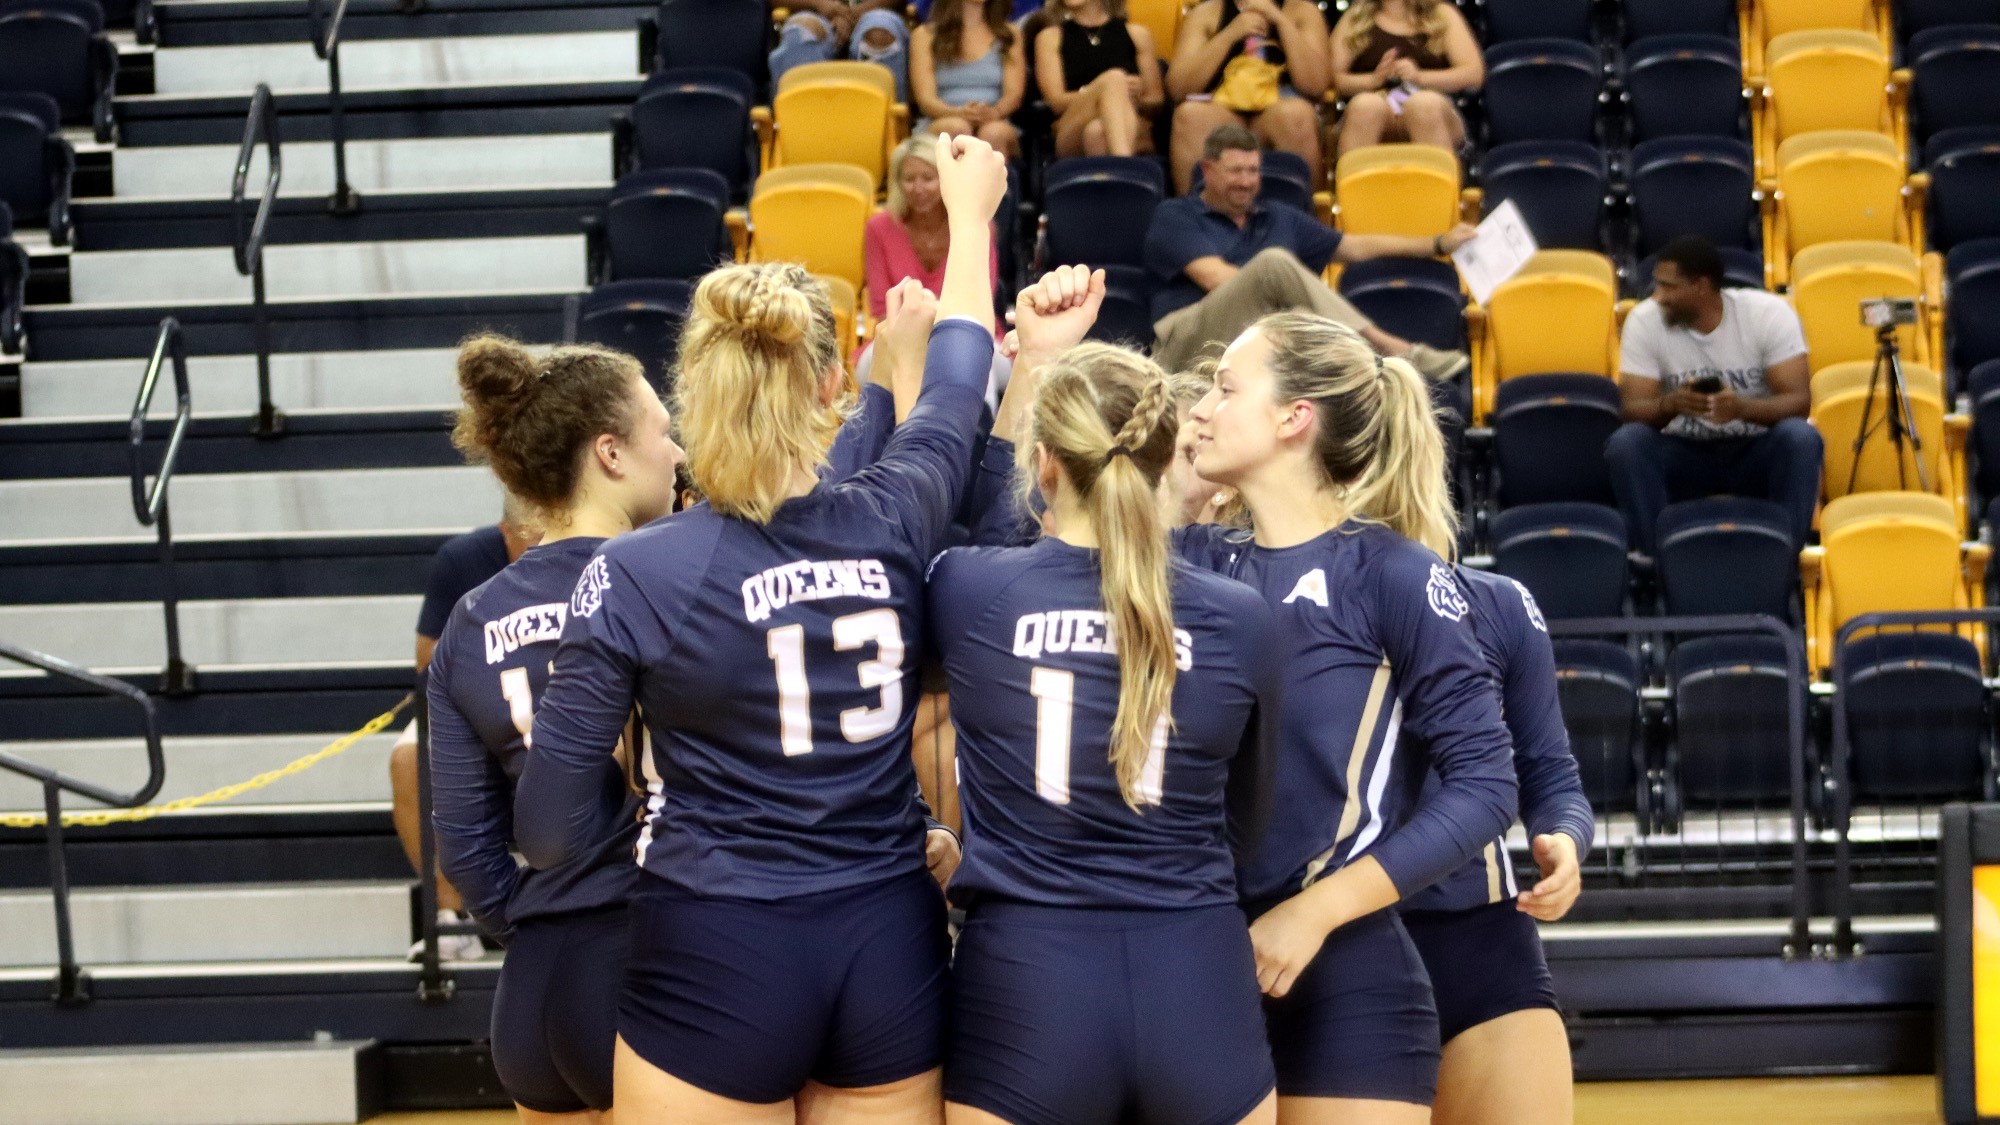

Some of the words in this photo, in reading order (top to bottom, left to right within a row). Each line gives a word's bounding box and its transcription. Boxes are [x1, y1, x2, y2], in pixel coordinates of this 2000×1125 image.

[741, 559, 891, 623] QUEENS
[484, 602, 569, 665] QUEE
[1012, 609, 1193, 672] QUES
[500, 660, 555, 750] 1
[767, 608, 905, 757] 13
